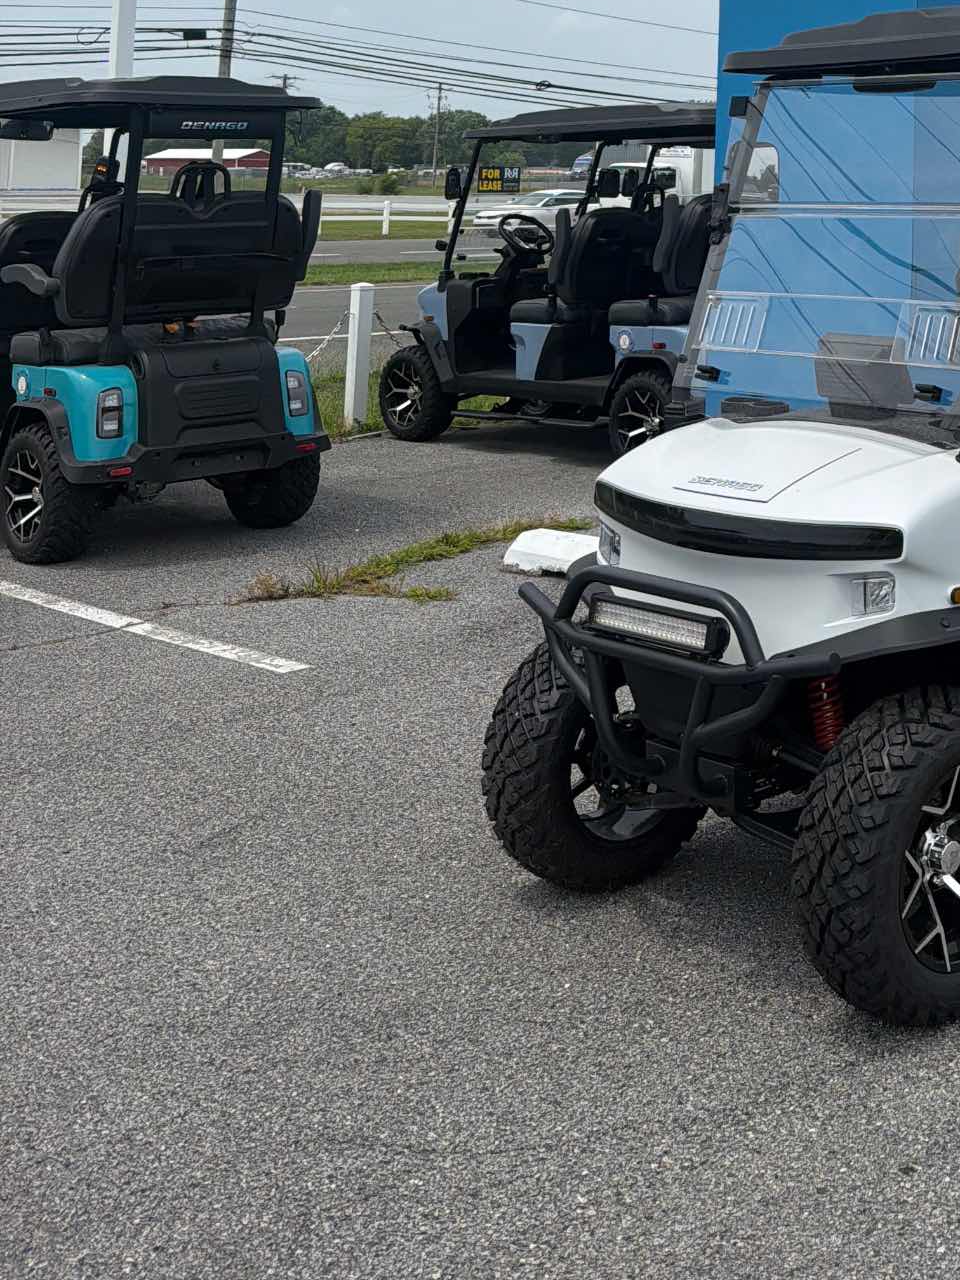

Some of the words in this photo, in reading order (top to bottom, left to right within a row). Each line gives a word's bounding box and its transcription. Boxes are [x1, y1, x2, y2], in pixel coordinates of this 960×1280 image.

[180, 121, 249, 130] DENAGO
[481, 168, 501, 179] FOR
[479, 180, 503, 191] LEASE
